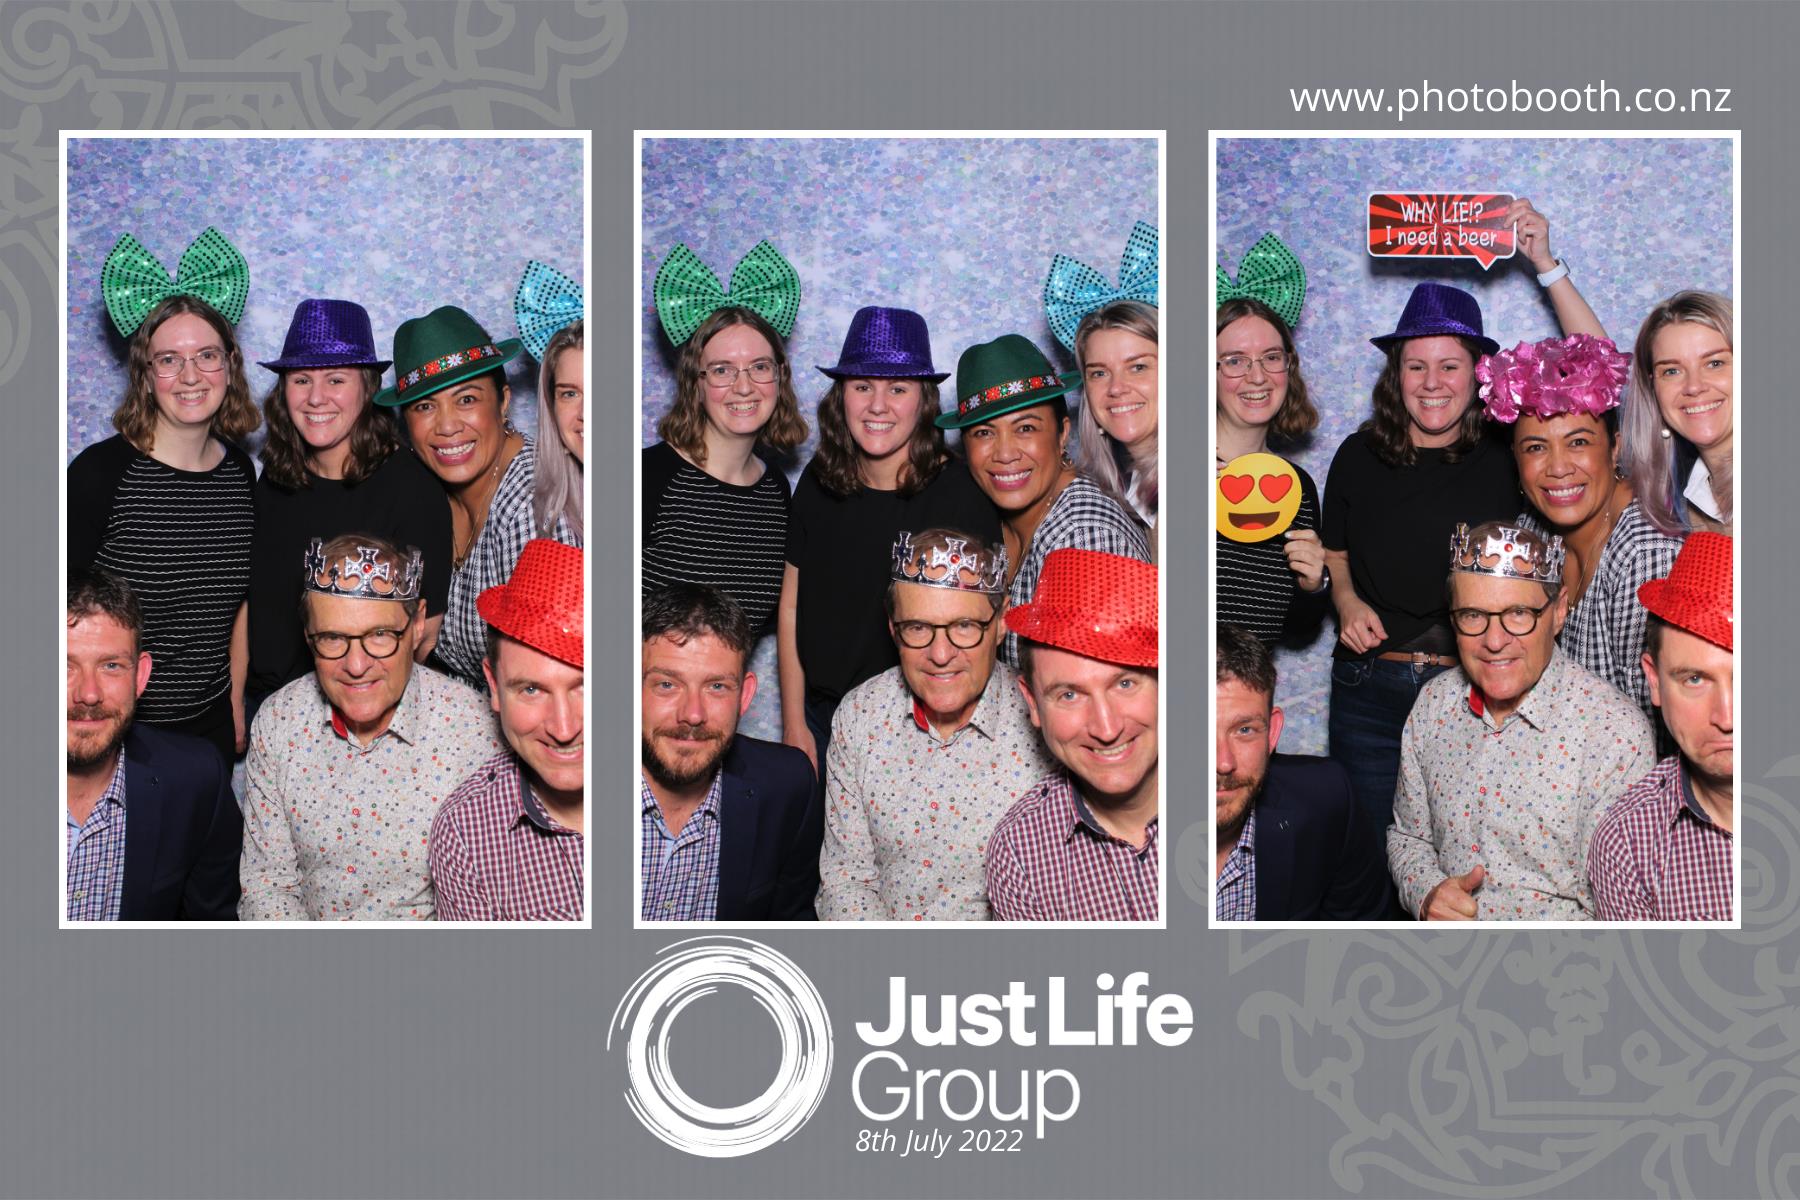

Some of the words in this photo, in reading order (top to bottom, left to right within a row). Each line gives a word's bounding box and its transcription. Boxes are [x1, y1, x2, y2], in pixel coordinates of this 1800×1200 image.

[1400, 201, 1437, 224] WHY
[1442, 201, 1483, 224] LIE!?
[1385, 225, 1392, 245] I
[1397, 223, 1437, 246] need
[1443, 232, 1453, 247] a
[1458, 225, 1498, 247] beer
